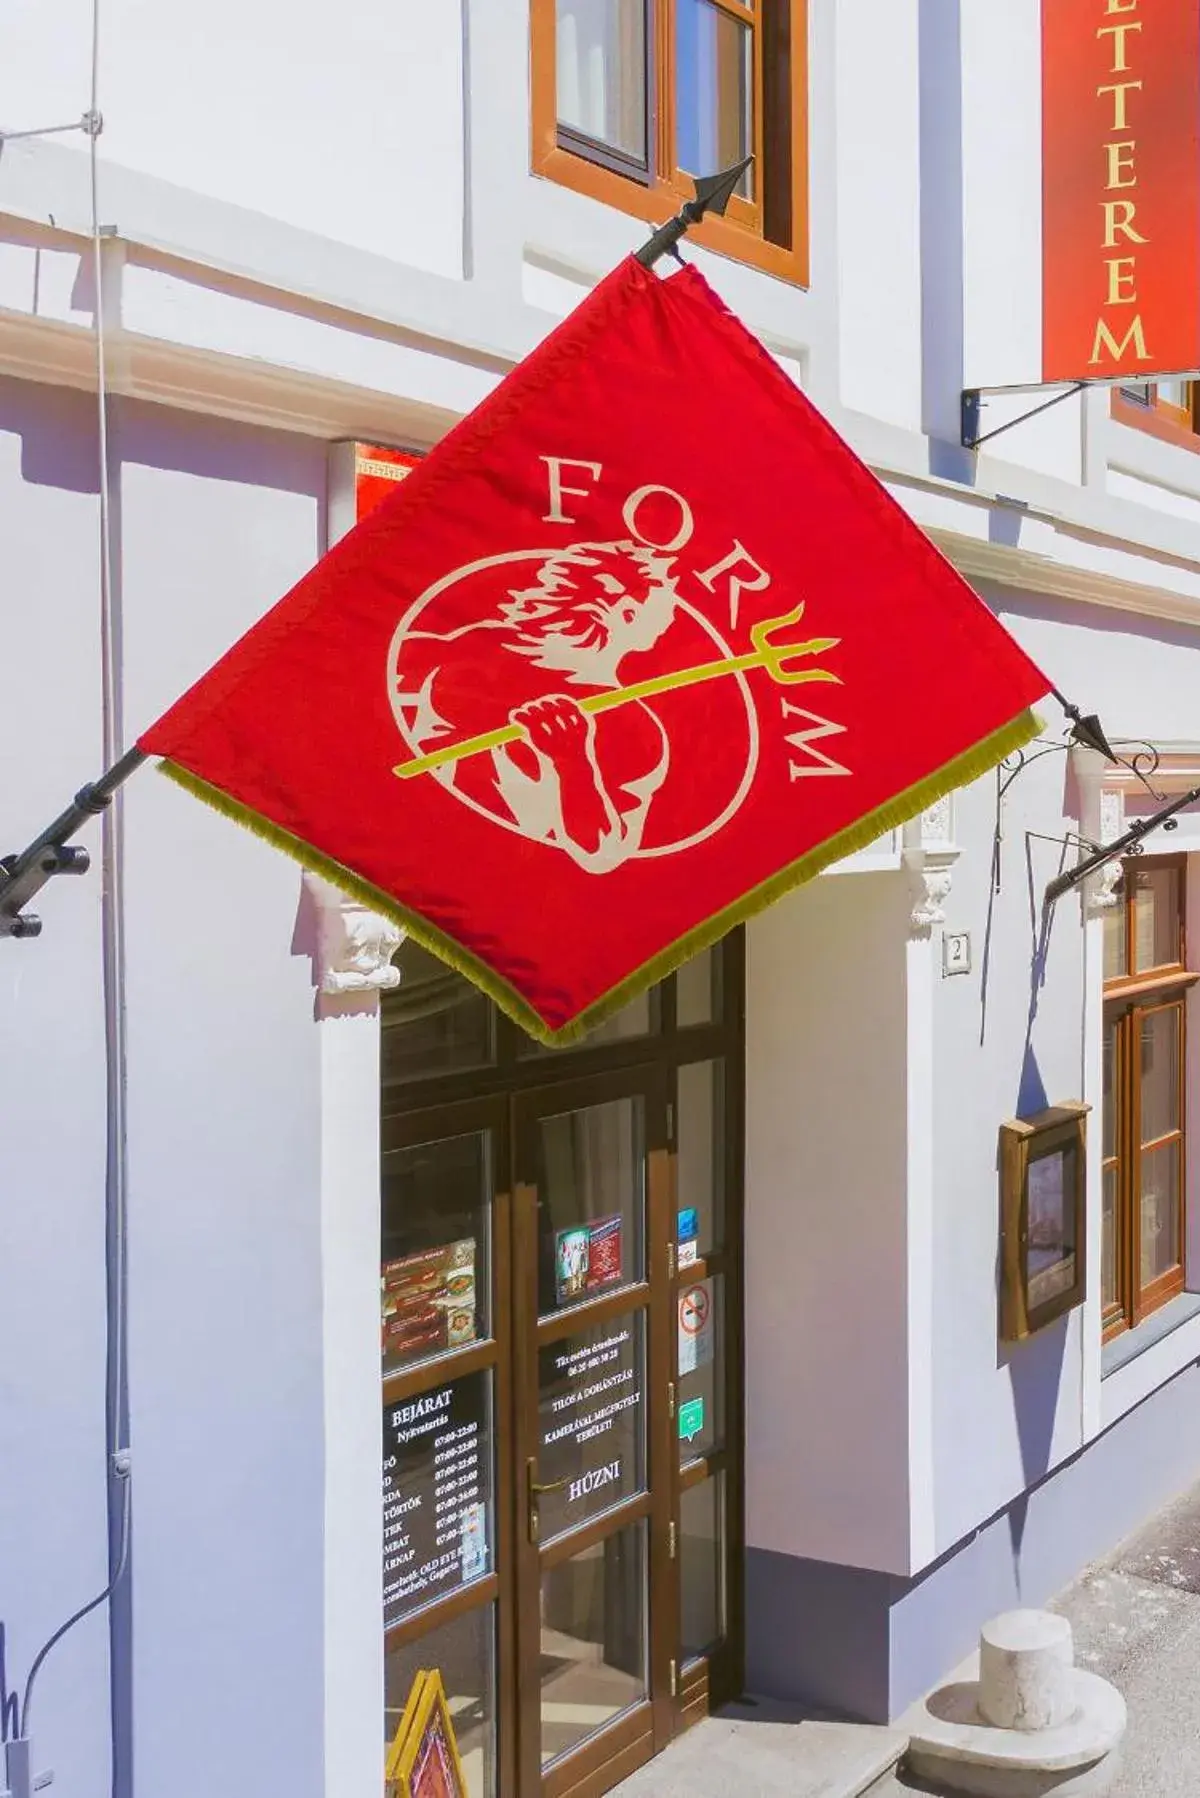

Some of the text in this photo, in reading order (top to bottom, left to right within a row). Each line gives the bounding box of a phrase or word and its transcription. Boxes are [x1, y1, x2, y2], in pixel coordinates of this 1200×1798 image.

[392, 1389, 454, 1428] BEJÁRAT
[552, 1393, 577, 1413] TILOS
[396, 1413, 449, 1444] Nyitvatartás
[434, 1421, 478, 1448] 07:00-22:00
[544, 1414, 593, 1445] KAMERÁVAL
[434, 1438, 478, 1465] 07:00-22:00
[568, 1460, 621, 1502] HÚZNI
